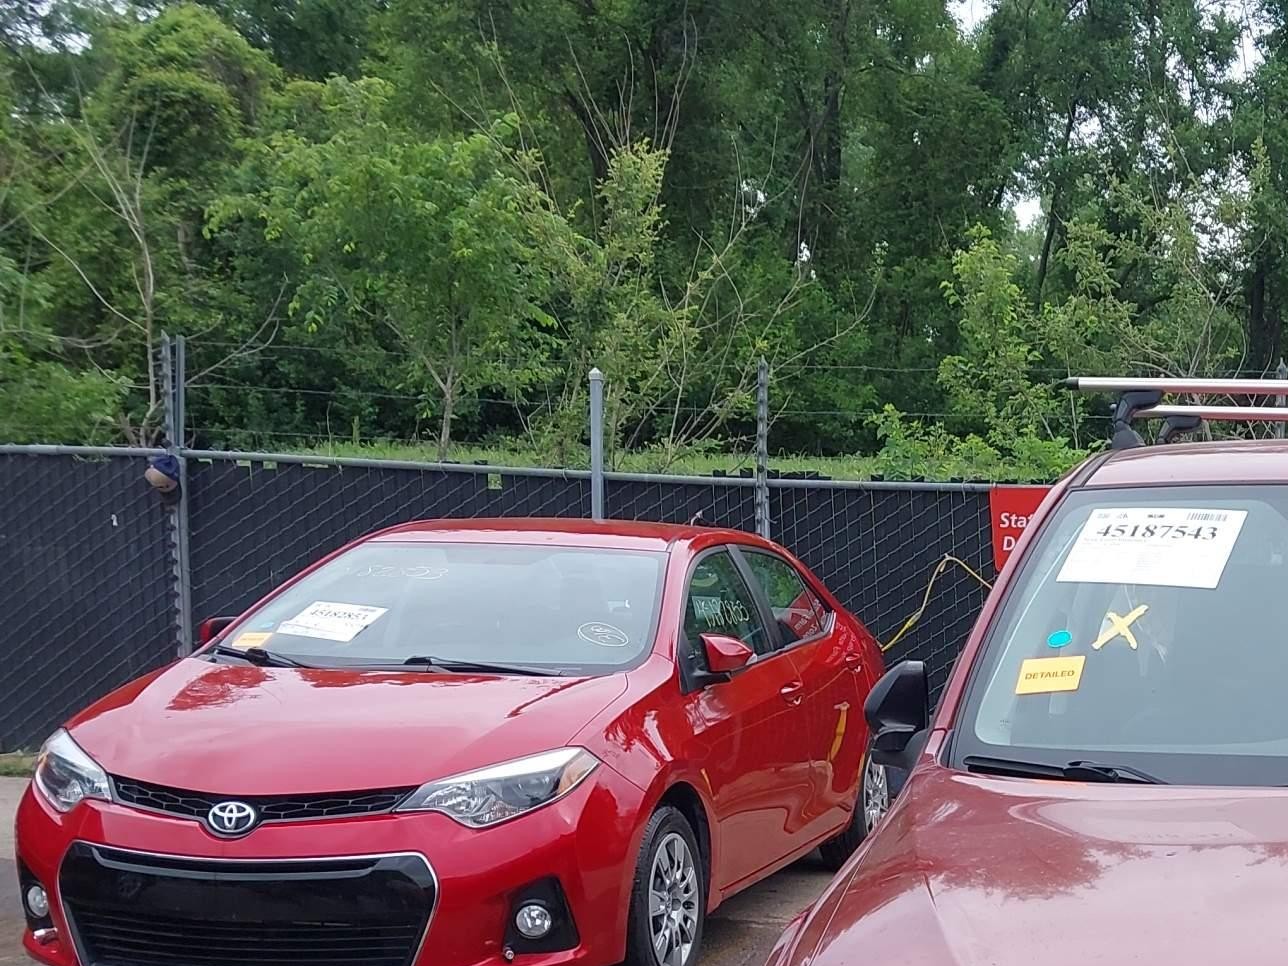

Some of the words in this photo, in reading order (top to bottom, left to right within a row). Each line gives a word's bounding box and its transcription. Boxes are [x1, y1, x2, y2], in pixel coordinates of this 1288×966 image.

[1096, 524, 1218, 540] 45187543
[1002, 535, 1016, 551] D
[1024, 670, 1075, 681] DETAILED
